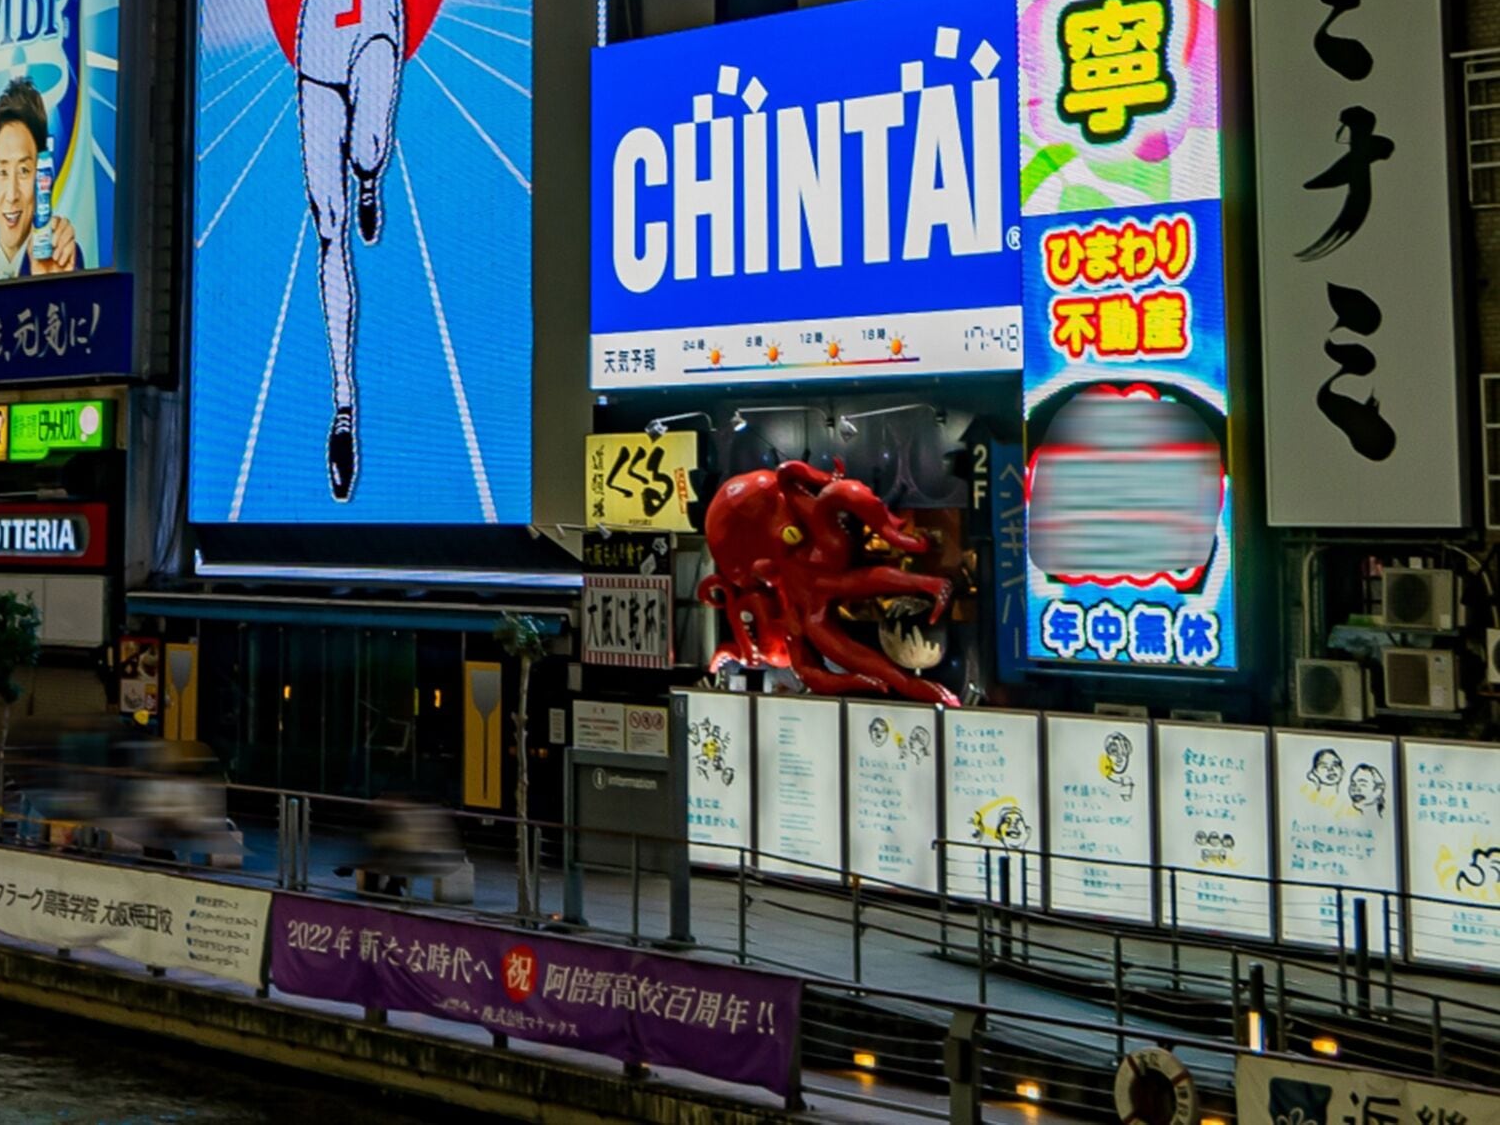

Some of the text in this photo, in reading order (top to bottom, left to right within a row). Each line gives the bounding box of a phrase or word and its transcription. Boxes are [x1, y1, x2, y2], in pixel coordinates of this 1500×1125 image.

[613, 27, 1003, 293] CHINTAI
[1044, 217, 1193, 285] ひまわり
[1053, 294, 1187, 358] 不動産
[603, 348, 657, 374] 天気予報
[973, 448, 987, 509] 2F
[1042, 600, 1219, 664] 年中無休
[287, 920, 351, 960] 2022年
[359, 929, 494, 983] 新たな時代へ
[506, 954, 532, 992] 祝
[543, 963, 749, 1034] 阿倍野高校百周年
